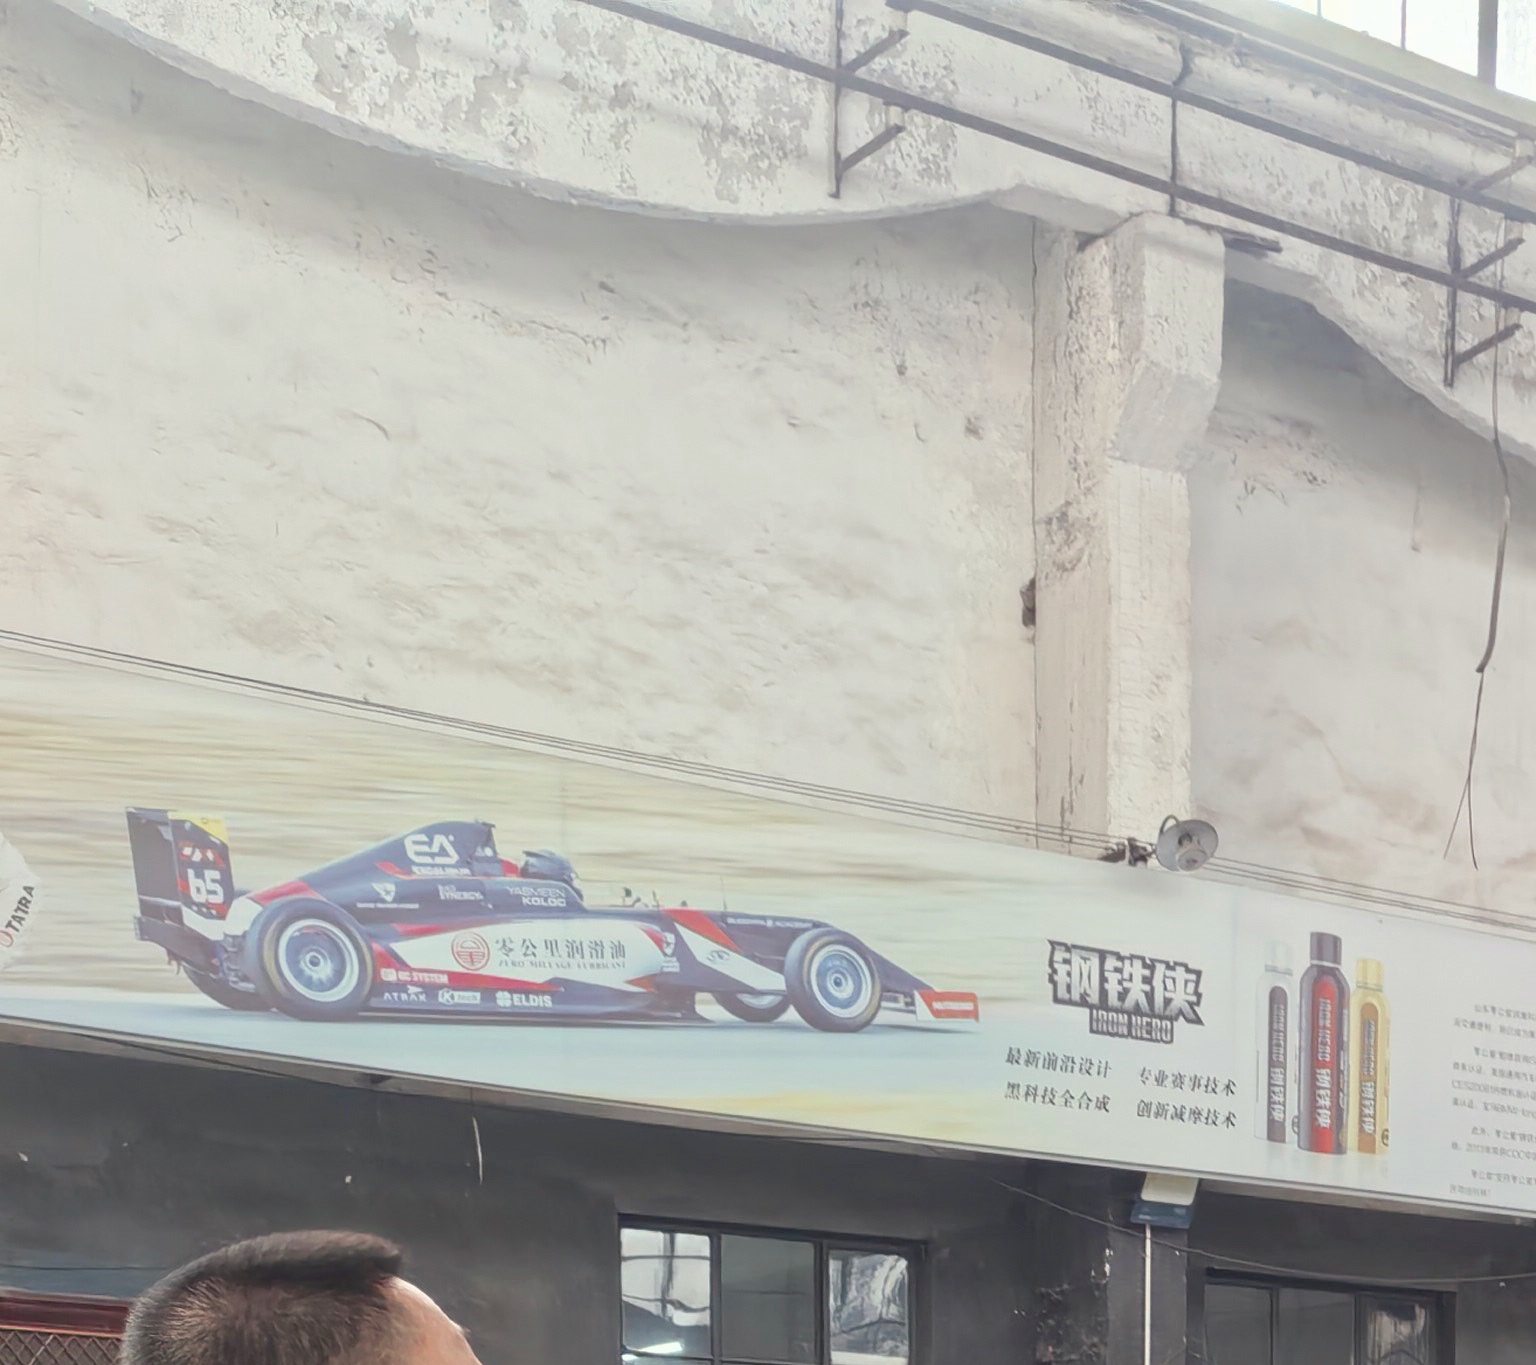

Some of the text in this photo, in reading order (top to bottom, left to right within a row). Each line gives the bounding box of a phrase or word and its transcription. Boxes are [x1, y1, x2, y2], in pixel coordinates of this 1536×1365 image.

[187, 868, 224, 903] 65
[5, 885, 35, 933] TATRA
[495, 936, 626, 960] 零公里润滑油
[1050, 943, 1201, 1021] 钢铁侠
[513, 992, 552, 1008] ELDIS
[1092, 1008, 1172, 1042] IRON HERO
[1005, 1047, 1112, 1079] 最新前沿设计
[1004, 1081, 1111, 1113] 黑科技全合成
[1138, 1066, 1237, 1097] 专业赛事技术
